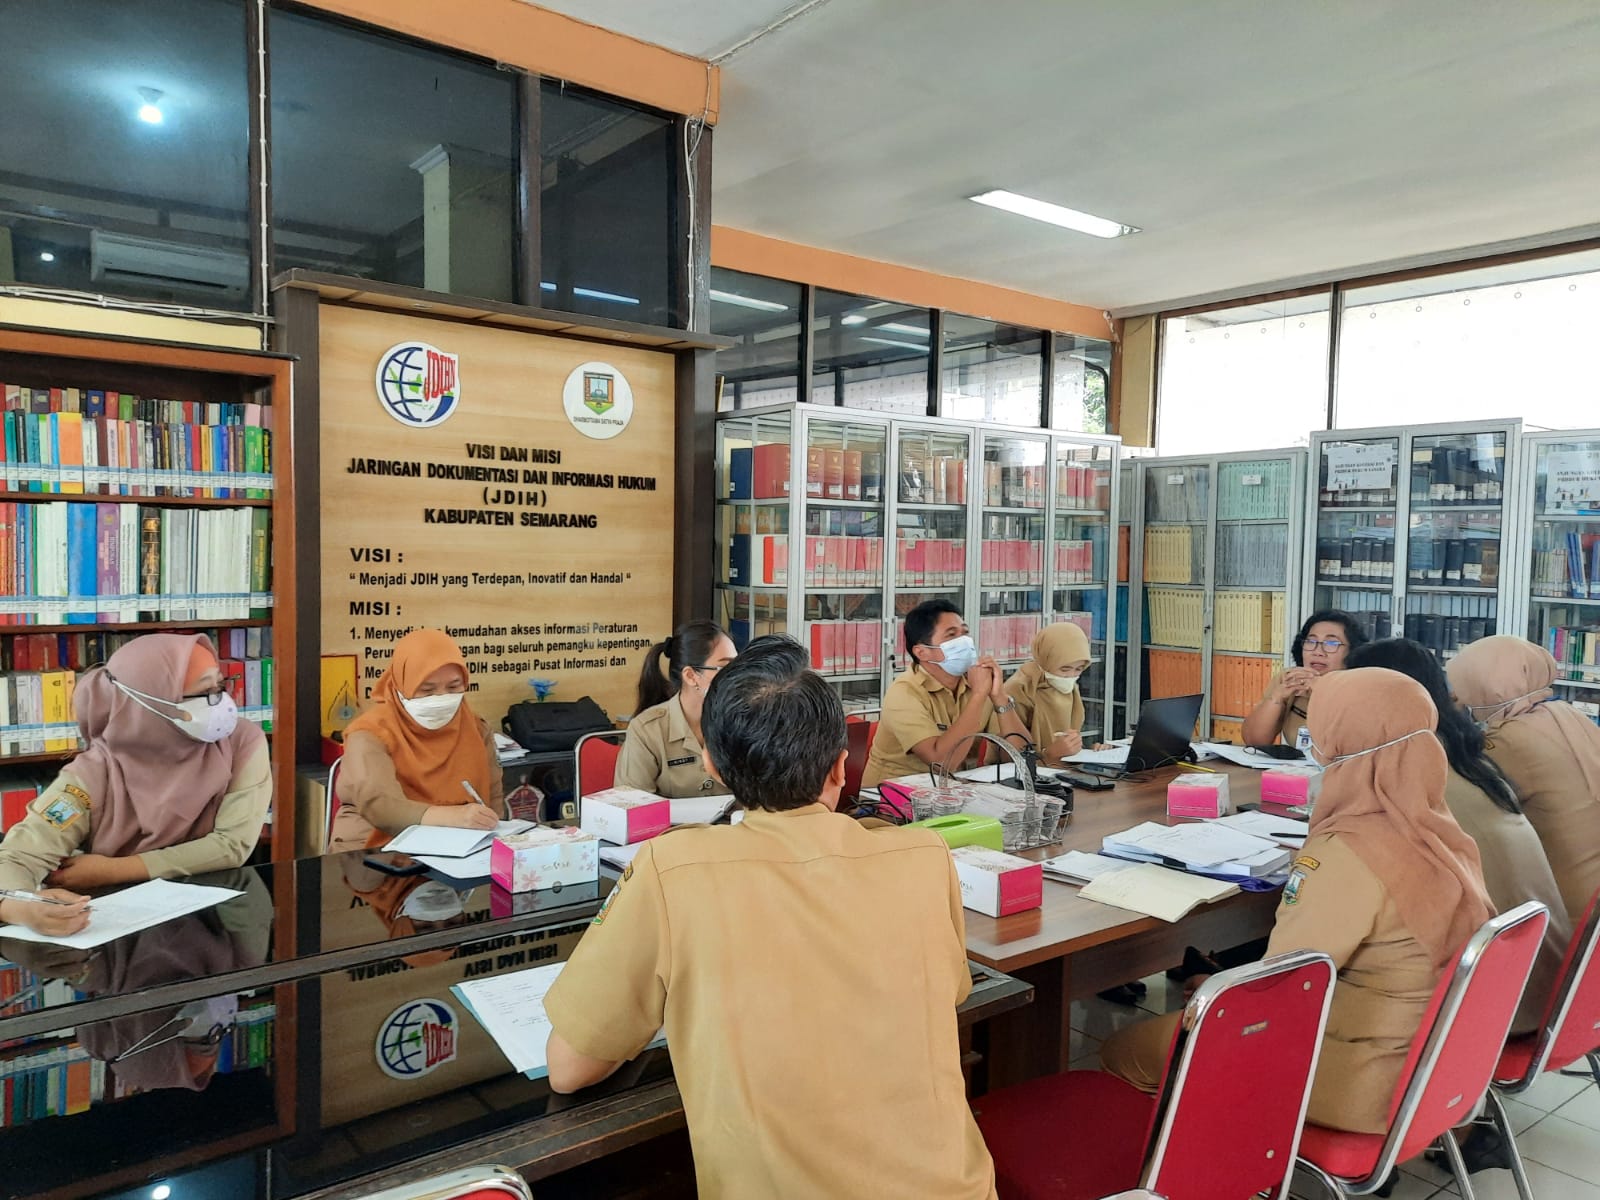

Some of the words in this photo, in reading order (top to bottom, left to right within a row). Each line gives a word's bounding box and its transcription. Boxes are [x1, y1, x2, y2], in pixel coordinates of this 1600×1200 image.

[465, 442, 495, 460] VISI
[500, 446, 528, 462] DAN
[532, 448, 561, 464] MISI
[347, 457, 421, 477] JARINGAN
[427, 463, 518, 485] DOKUMENTASI
[523, 469, 548, 485] DAN
[552, 471, 614, 488] INFORMASI
[618, 475, 656, 491] HUKUM
[424, 508, 514, 526] KABUPATEN
[520, 511, 597, 528] SEMARANG
[350, 548, 391, 563] VISI
[359, 572, 407, 588] Menjadi
[410, 572, 438, 585] JDIH
[442, 574, 468, 588] yang
[472, 572, 525, 587] Terdepan,
[528, 572, 567, 584] Inovatif
[569, 572, 587, 584] dan
[590, 572, 624, 584] Handal
[349, 601, 390, 616] MISI
[350, 626, 360, 640] 1.
[445, 625, 507, 638] kemudahan
[510, 624, 541, 636] akses
[543, 623, 590, 635] informasi
[592, 622, 638, 634] Peraturan
[484, 642, 505, 657] bagi
[507, 640, 544, 654] seluruh
[546, 638, 595, 654] pemangku
[491, 658, 531, 675] sebagai
[533, 657, 561, 671] Pusat
[563, 655, 608, 670] Informasi
[610, 655, 627, 668] dan
